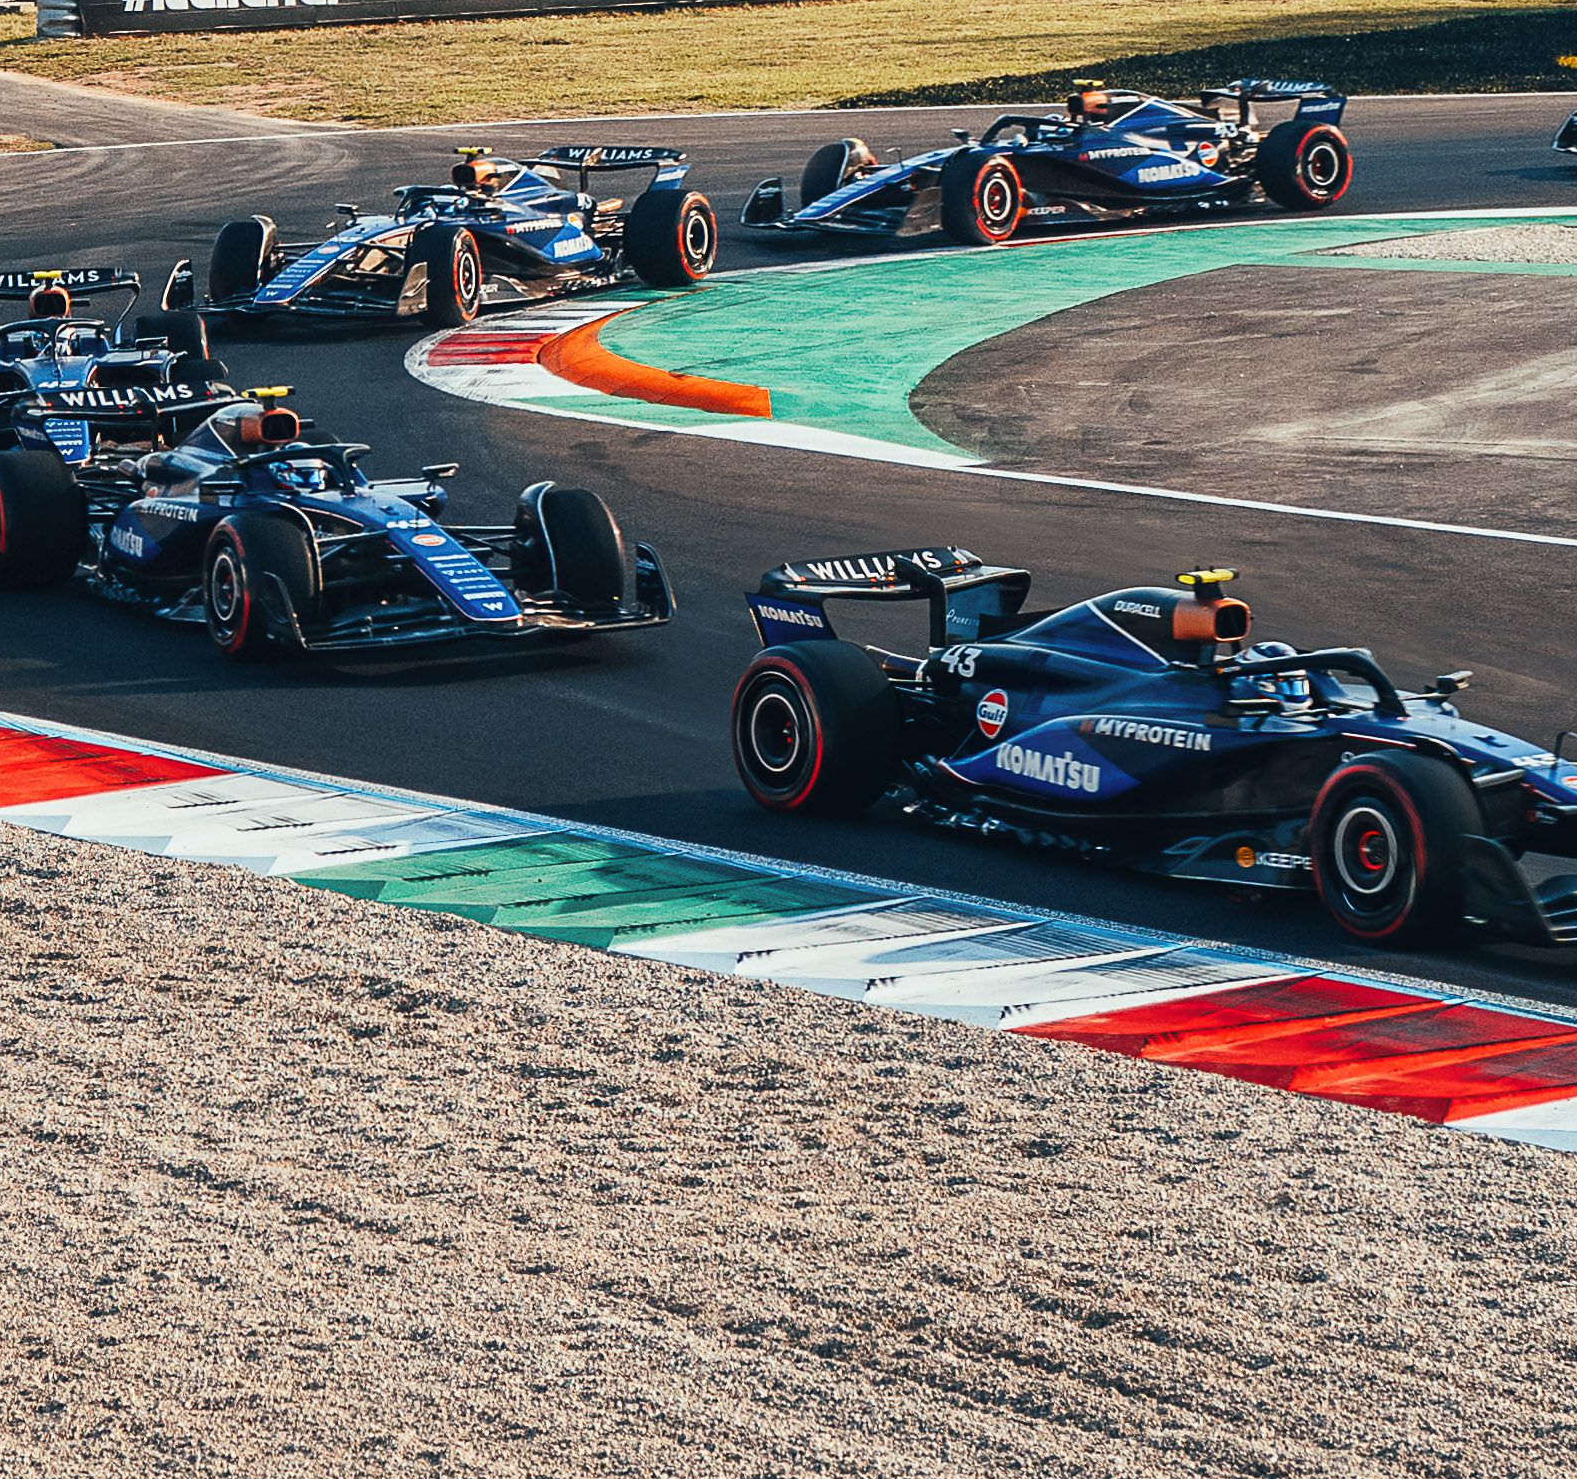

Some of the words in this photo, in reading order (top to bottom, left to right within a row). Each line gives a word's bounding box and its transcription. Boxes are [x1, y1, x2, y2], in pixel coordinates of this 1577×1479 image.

[757, 604, 823, 628] KOMATSU
[1114, 600, 1161, 619] DURACELL
[940, 645, 983, 677] 43
[978, 703, 1006, 723] Gulf
[1094, 719, 1212, 751] MYPROTEIN
[996, 743, 1101, 793] KOMATSU
